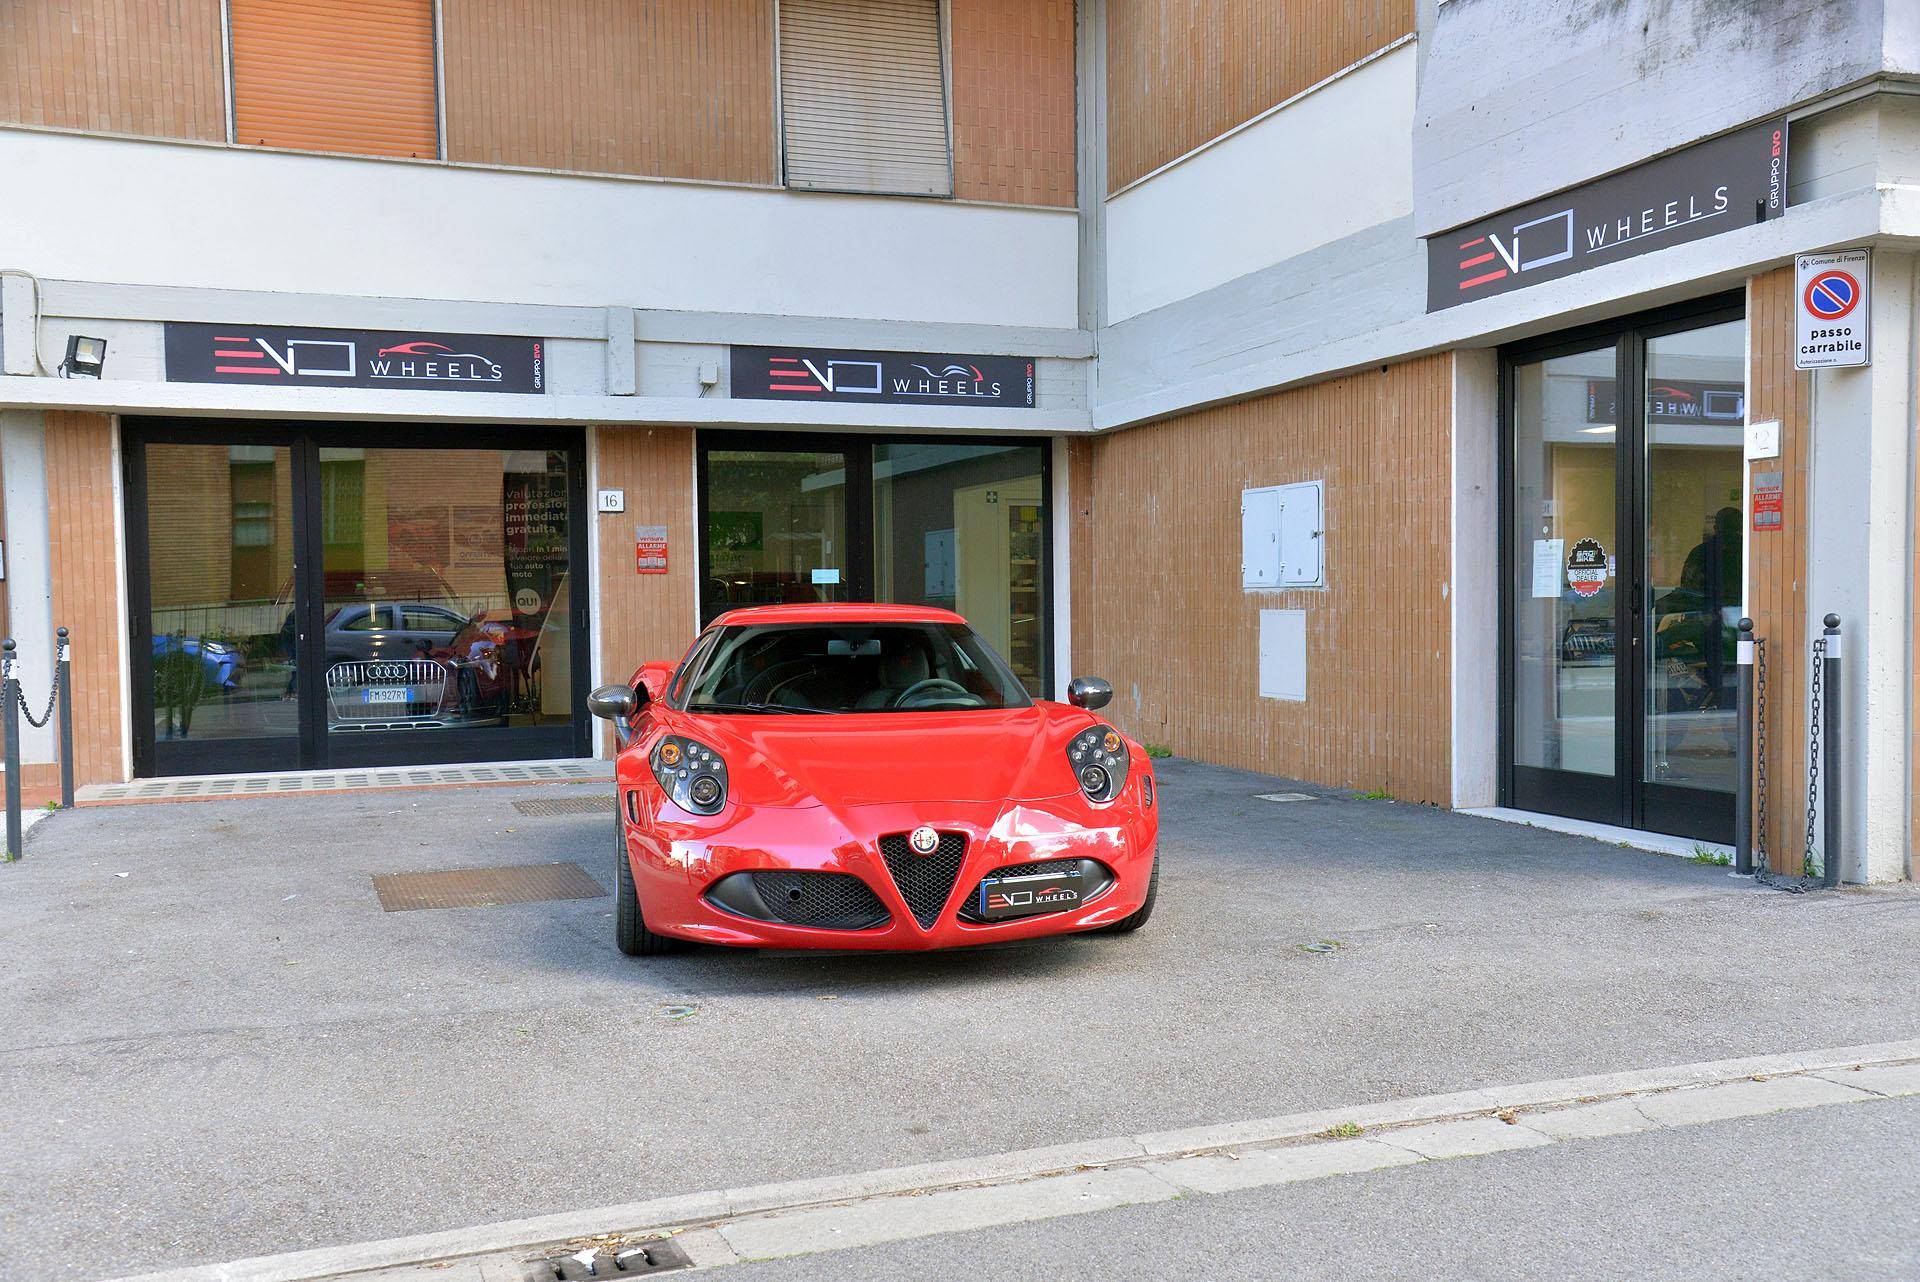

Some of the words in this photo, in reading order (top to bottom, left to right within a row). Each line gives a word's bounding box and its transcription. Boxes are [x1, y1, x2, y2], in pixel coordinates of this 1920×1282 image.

[1771, 130, 1782, 156] EVO
[1770, 157, 1781, 209] GRUPPO
[1459, 208, 1574, 290] EVO
[1586, 186, 1729, 249] WHEELS
[1811, 258, 1835, 266] Comune
[1844, 255, 1865, 263] Firenze
[1811, 327, 1852, 340] passo
[533, 343, 541, 359] EVO
[1801, 340, 1862, 354] carrabile
[213, 336, 356, 378] EVO
[370, 360, 503, 380] WHEELS
[533, 358, 541, 389] GRUPPO
[769, 357, 882, 394] EVO
[893, 379, 1001, 396] WHEELS
[605, 495, 618, 507] 16
[506, 523, 556, 536] gratuita
[517, 597, 537, 606] QUI
[369, 691, 380, 700] FM
[382, 690, 406, 700] 927RY
[989, 891, 1032, 908] EVO
[1035, 892, 1078, 902] WHEELS
